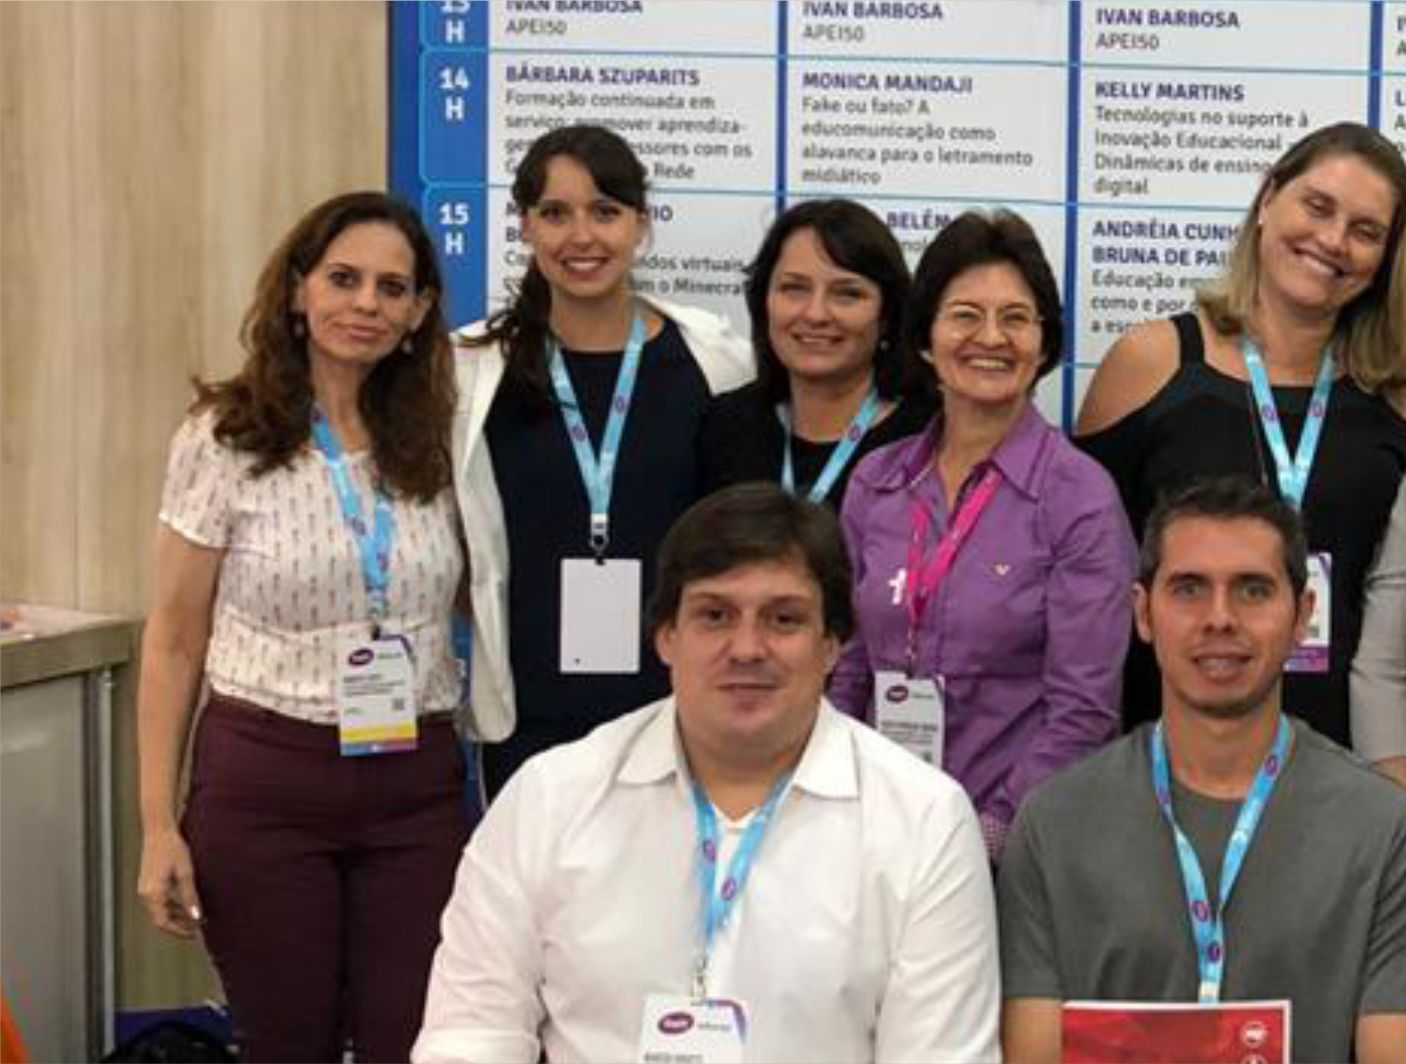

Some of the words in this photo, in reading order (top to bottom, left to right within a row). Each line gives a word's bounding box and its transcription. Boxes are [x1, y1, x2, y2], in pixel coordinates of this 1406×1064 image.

[506, 0, 549, 11] IVAN
[556, 0, 643, 13] BARBOSA
[802, 1, 848, 17] IVAN
[853, 3, 943, 19] BARBOSA
[1096, 9, 1143, 26] IVAN
[1149, 11, 1241, 28] BARBOSA
[445, 21, 465, 43] H
[440, 67, 470, 90] 14
[506, 63, 594, 84] BÁRBARA
[599, 69, 700, 86] SZUPARITS
[884, 75, 973, 94] MANDAJI
[506, 90, 585, 109] Formação
[591, 92, 685, 110] continuada
[690, 97, 715, 109] em
[1096, 80, 1152, 98] KELLY
[1156, 83, 1245, 101] MARTINS
[445, 97, 465, 120] H
[802, 96, 841, 112] Fake
[845, 101, 866, 113] ou
[871, 97, 913, 114] fato?
[917, 100, 930, 114] A
[657, 118, 746, 135] aprendiza-
[1096, 106, 1196, 127] Tecnologias
[1201, 112, 1222, 125] no
[1228, 113, 1293, 132] suporte
[1298, 111, 1308, 127] à
[1394, 116, 1406, 131] A
[802, 122, 945, 142] educomunicação
[949, 127, 996, 140] como
[1096, 130, 1172, 152] Inovação
[1177, 132, 1281, 151] Educacional
[694, 145, 729, 157] com
[733, 145, 753, 158] os
[802, 145, 876, 162] alavanca
[880, 149, 918, 166] para
[923, 151, 933, 163] o
[938, 147, 1034, 166] letramento
[653, 164, 695, 179] Rede
[1095, 153, 1185, 173] Dinâmicas
[1189, 156, 1211, 173] de
[802, 167, 882, 184] midiático
[1094, 176, 1149, 197] digital
[440, 203, 469, 226] 15
[1093, 218, 1180, 240] ANDRÉIA
[1184, 222, 1239, 240] CUNH
[445, 233, 464, 255] H
[1092, 245, 1160, 264] BRUNA
[1165, 247, 1191, 266] DE
[1092, 269, 1175, 291] Educação
[1091, 297, 1138, 311] como
[1143, 300, 1153, 312] e
[1156, 301, 1186, 315] por
